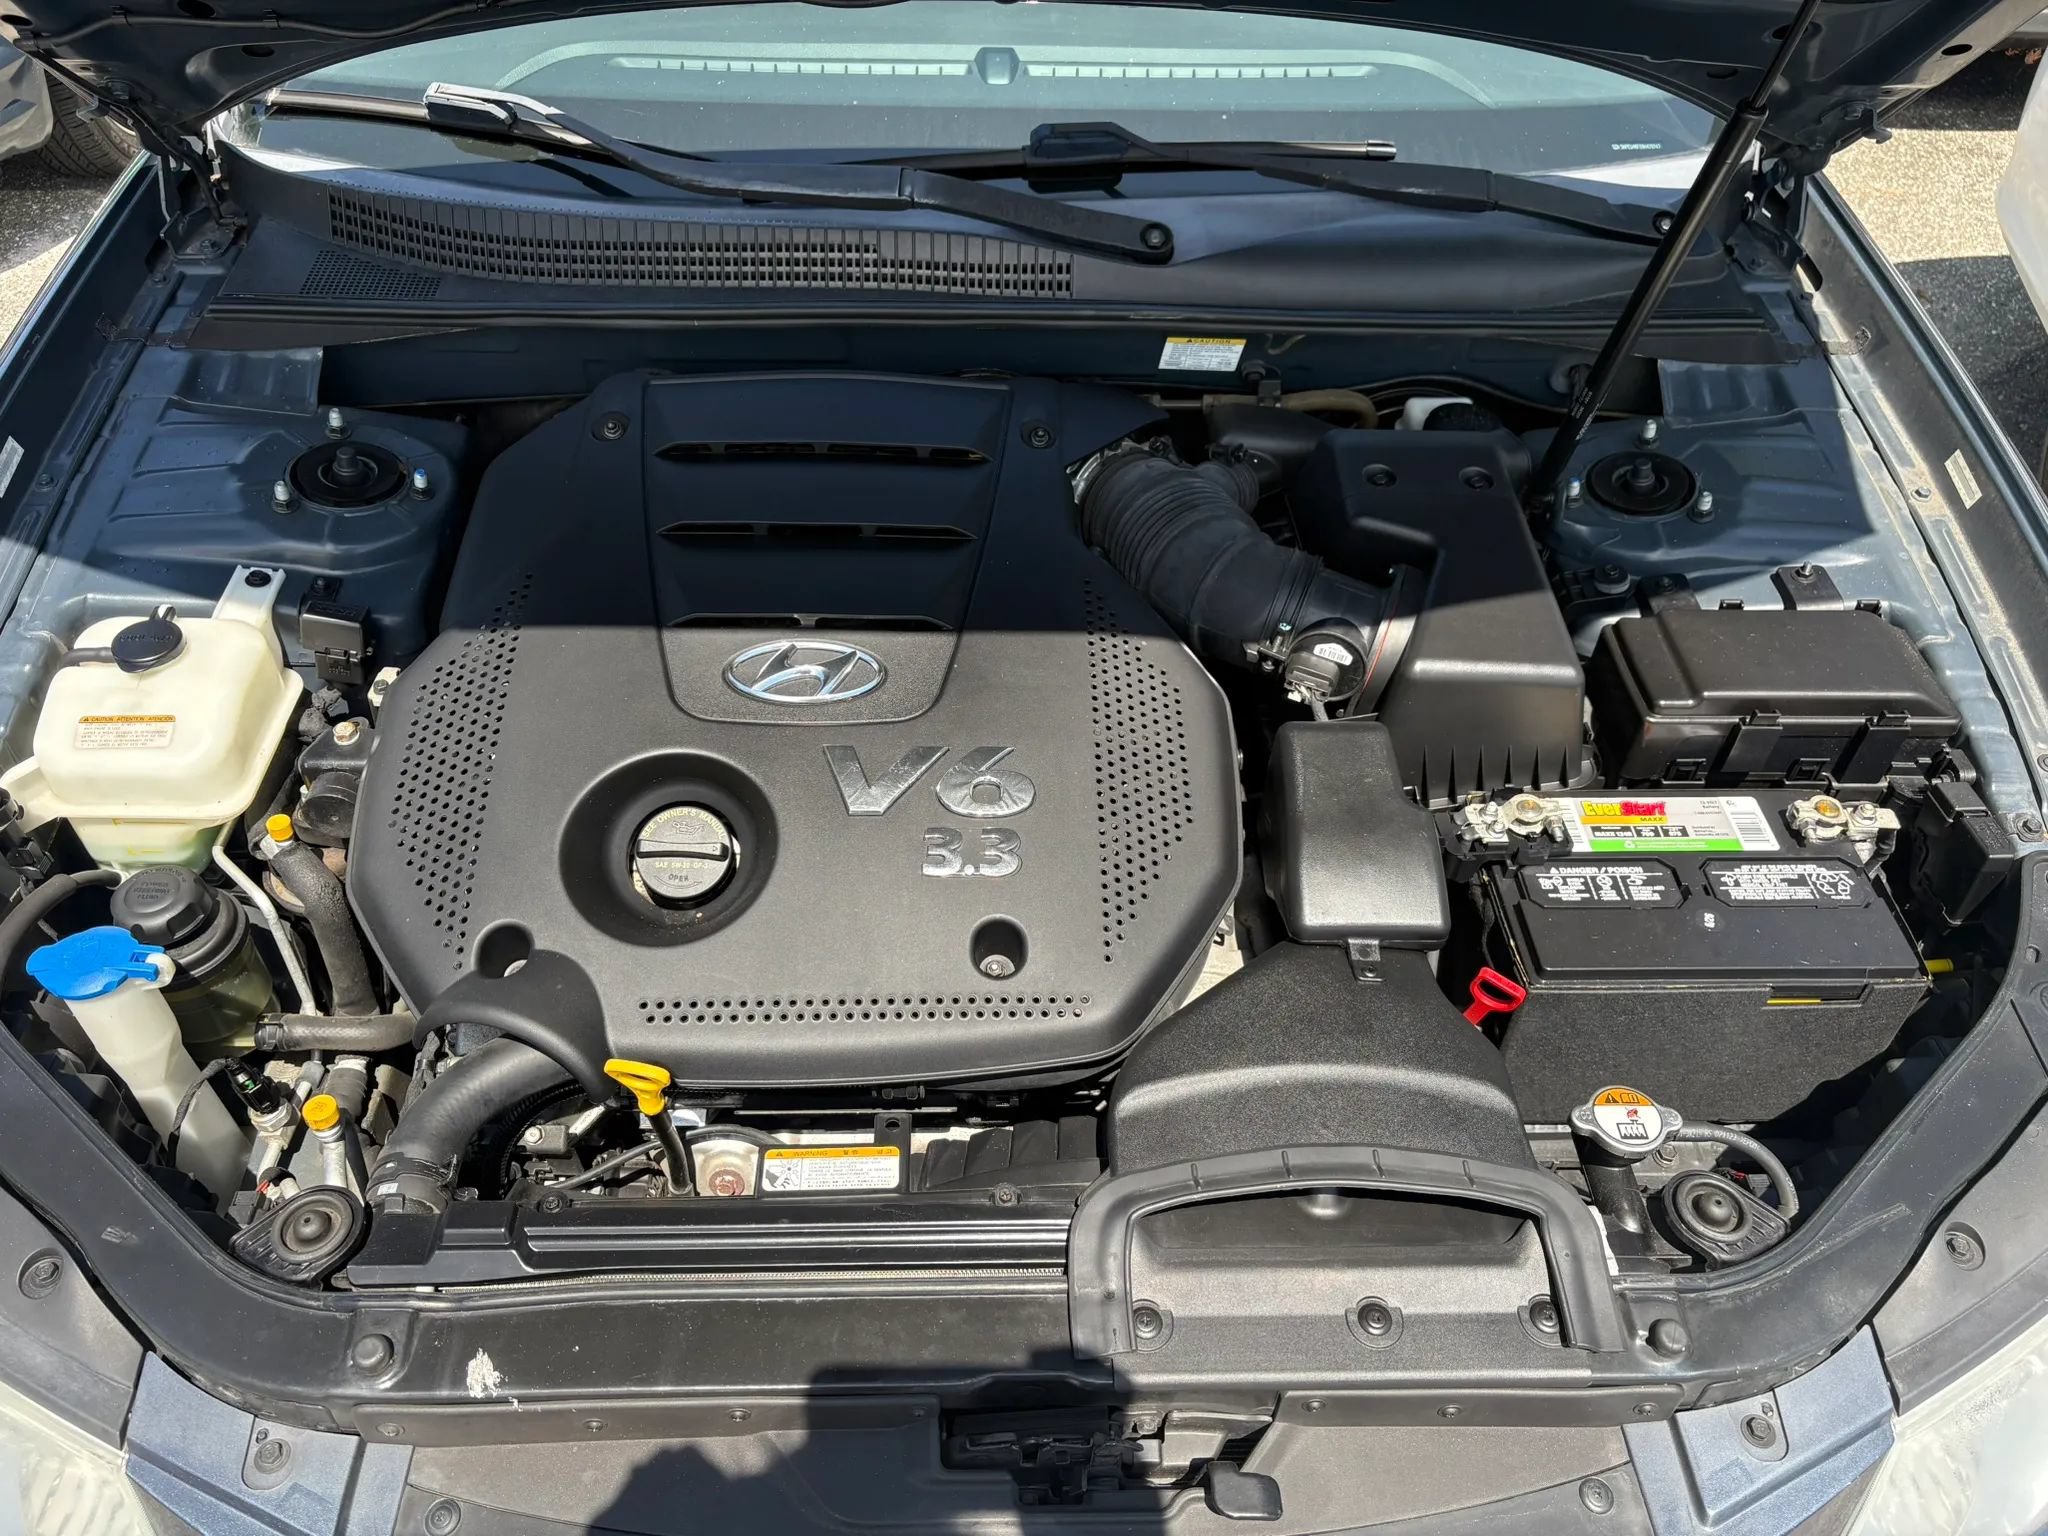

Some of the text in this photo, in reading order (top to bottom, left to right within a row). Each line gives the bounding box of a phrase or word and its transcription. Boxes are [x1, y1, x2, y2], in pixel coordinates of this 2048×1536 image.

[822, 743, 1037, 818] V6
[643, 808, 727, 840] SEE OWNER'S MANUAL
[1581, 800, 1666, 816] EverStart
[922, 827, 1023, 878] 3.3
[1607, 866, 1644, 874] POISON
